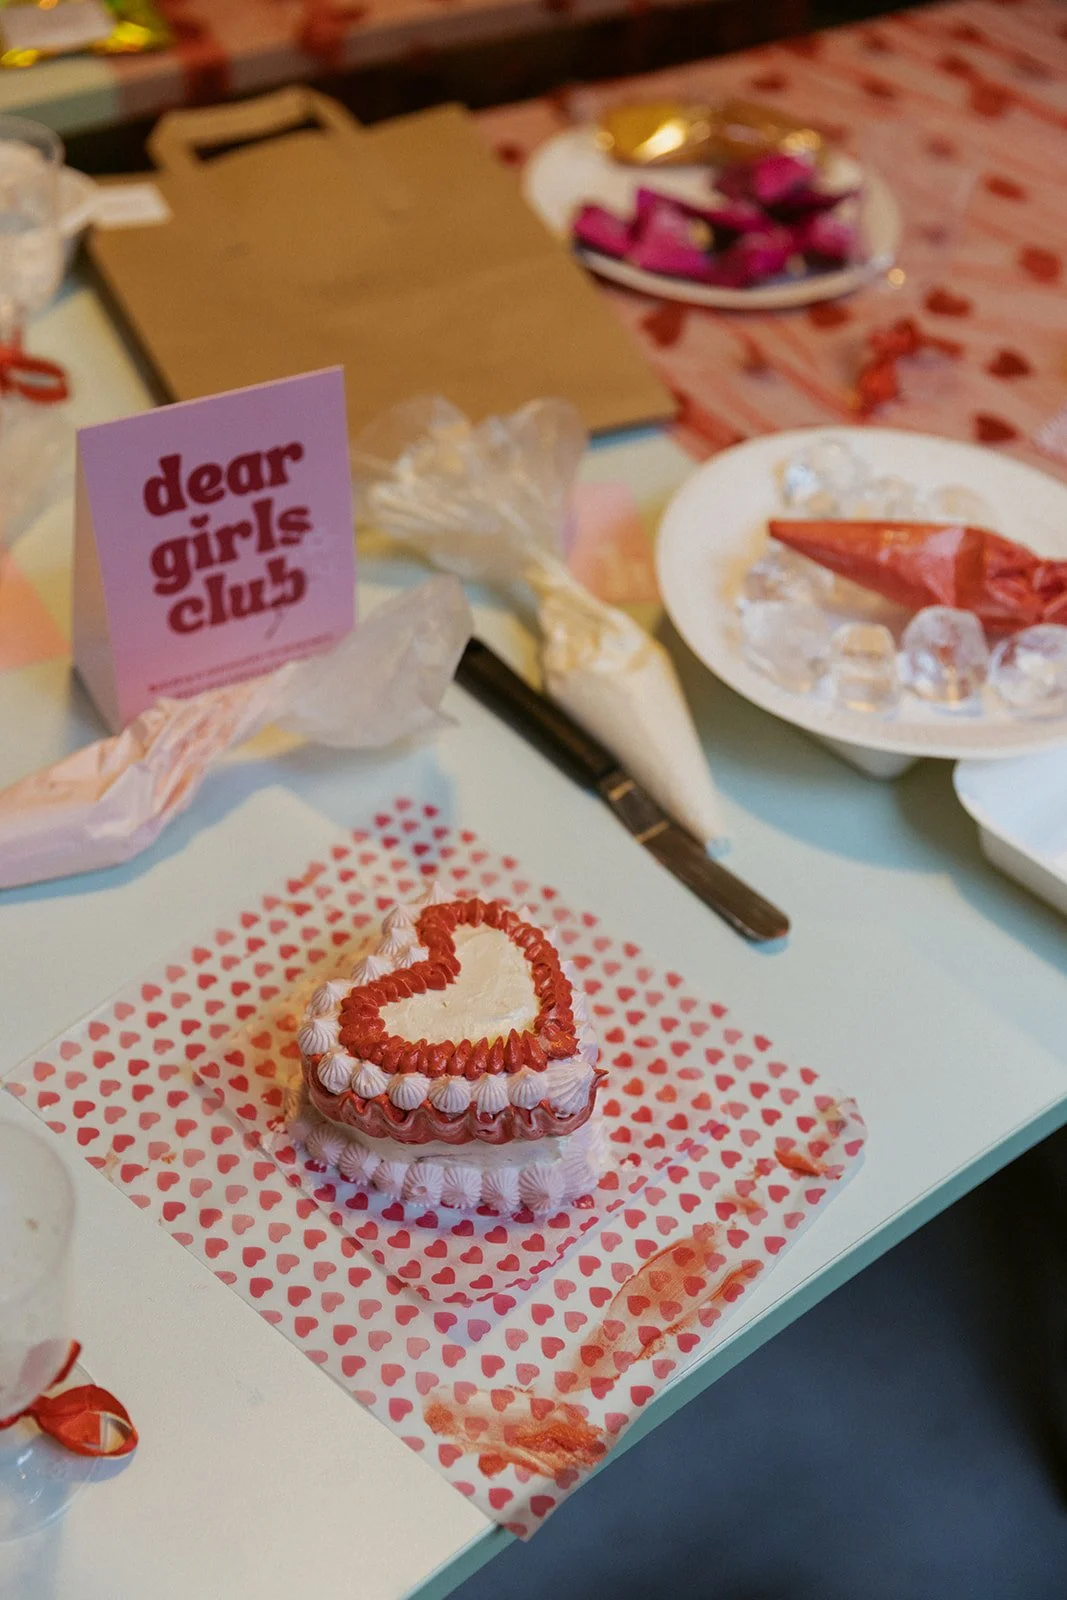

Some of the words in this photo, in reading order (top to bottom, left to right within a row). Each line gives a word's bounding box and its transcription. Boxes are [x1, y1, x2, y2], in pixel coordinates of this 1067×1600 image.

[143, 441, 305, 517] dear
[150, 497, 313, 596] girls
[167, 557, 307, 636] club
